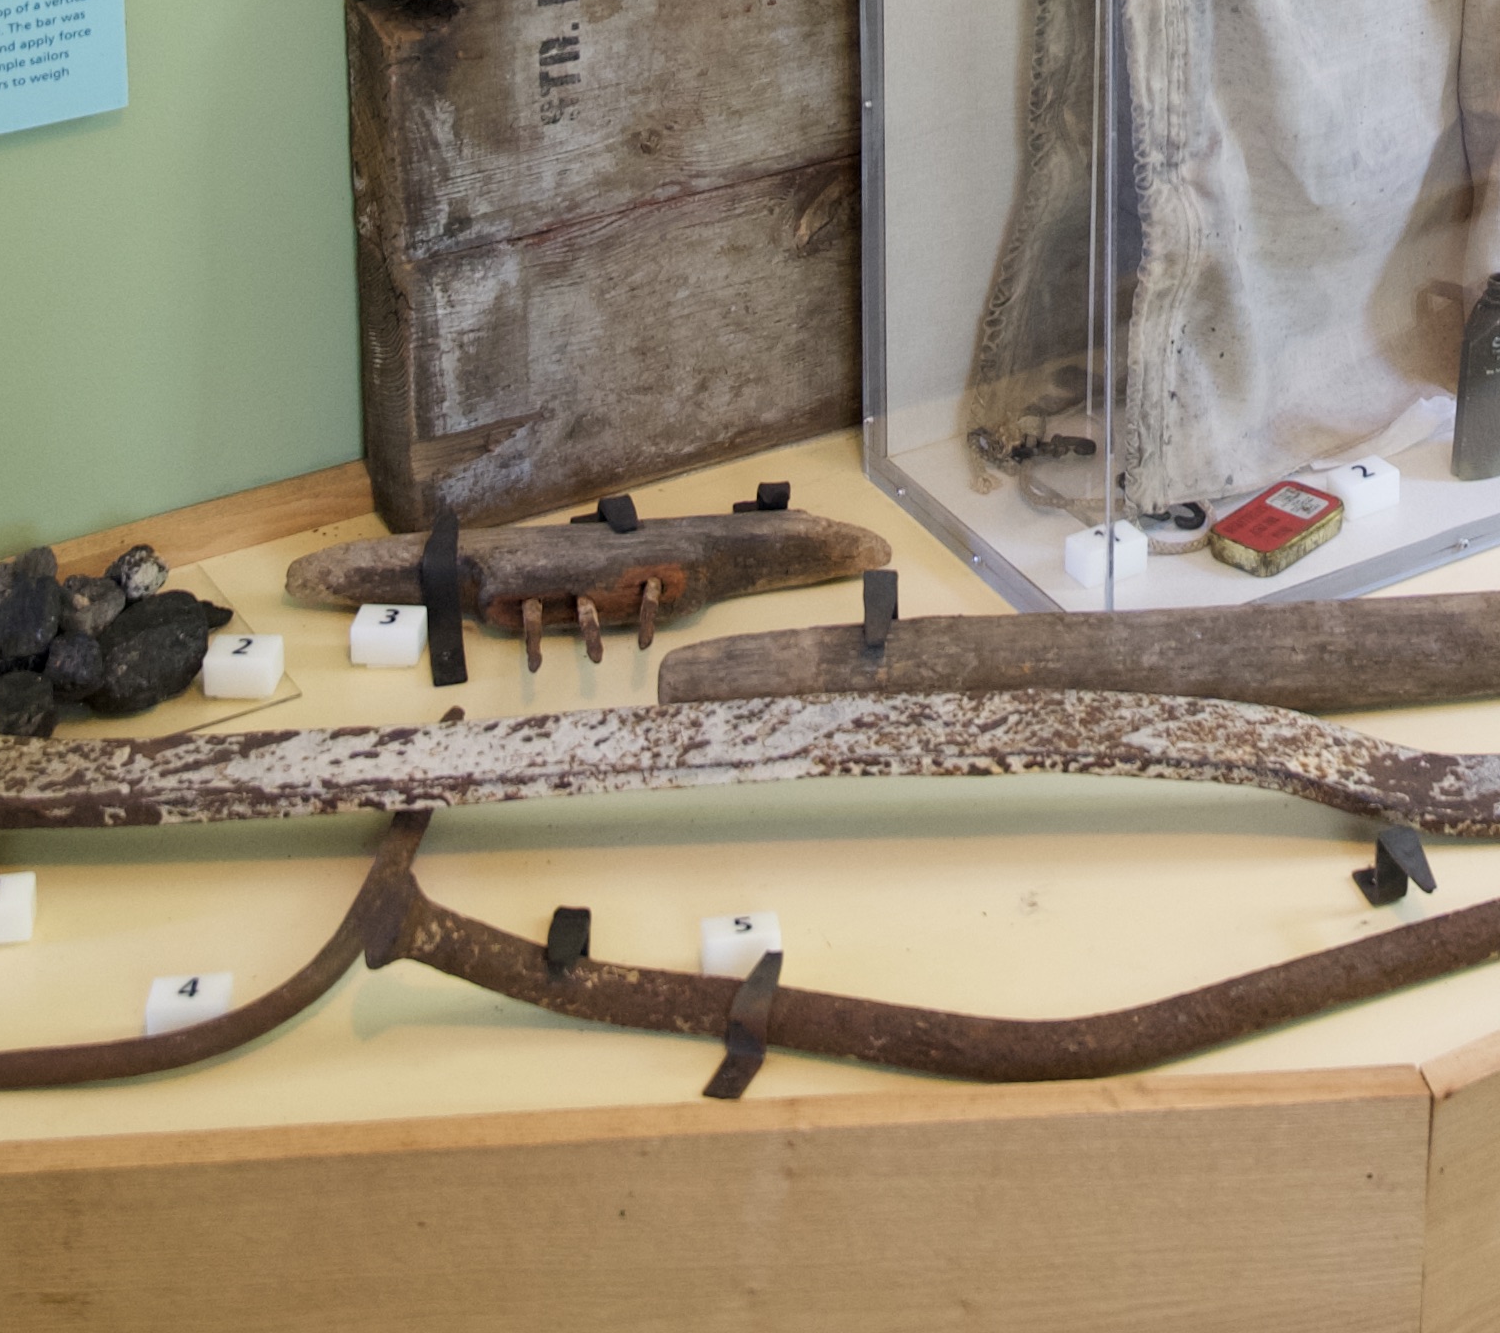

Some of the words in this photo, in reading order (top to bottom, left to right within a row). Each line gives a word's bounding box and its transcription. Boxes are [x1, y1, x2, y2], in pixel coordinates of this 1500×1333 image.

[1351, 465, 1374, 478] 2
[380, 609, 399, 624] 3
[232, 638, 253, 654] 2
[734, 917, 752, 933] 5
[178, 978, 199, 997] 4
